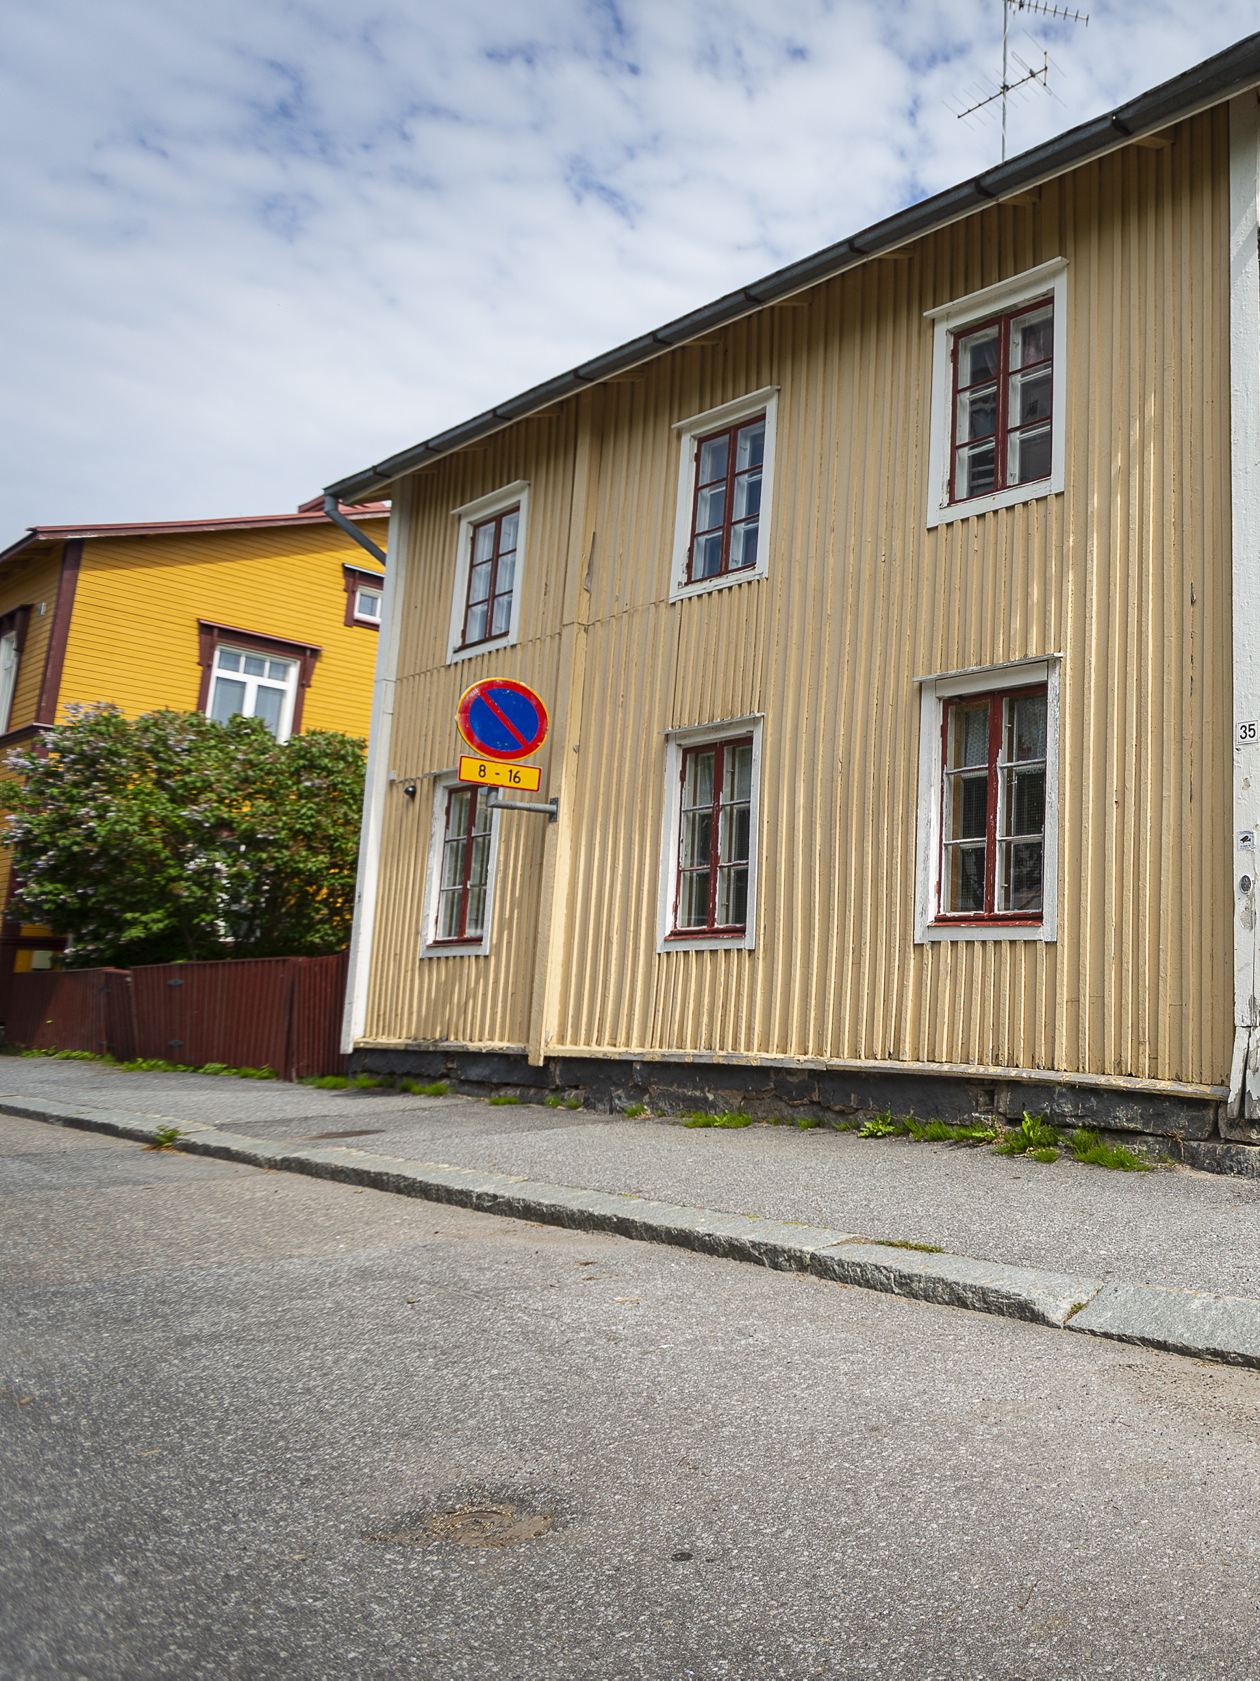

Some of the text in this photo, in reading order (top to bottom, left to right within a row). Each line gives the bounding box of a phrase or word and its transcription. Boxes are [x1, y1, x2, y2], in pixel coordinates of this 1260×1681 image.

[1239, 723, 1256, 739] 35
[478, 764, 486, 778] 8
[508, 769, 522, 784] 16
